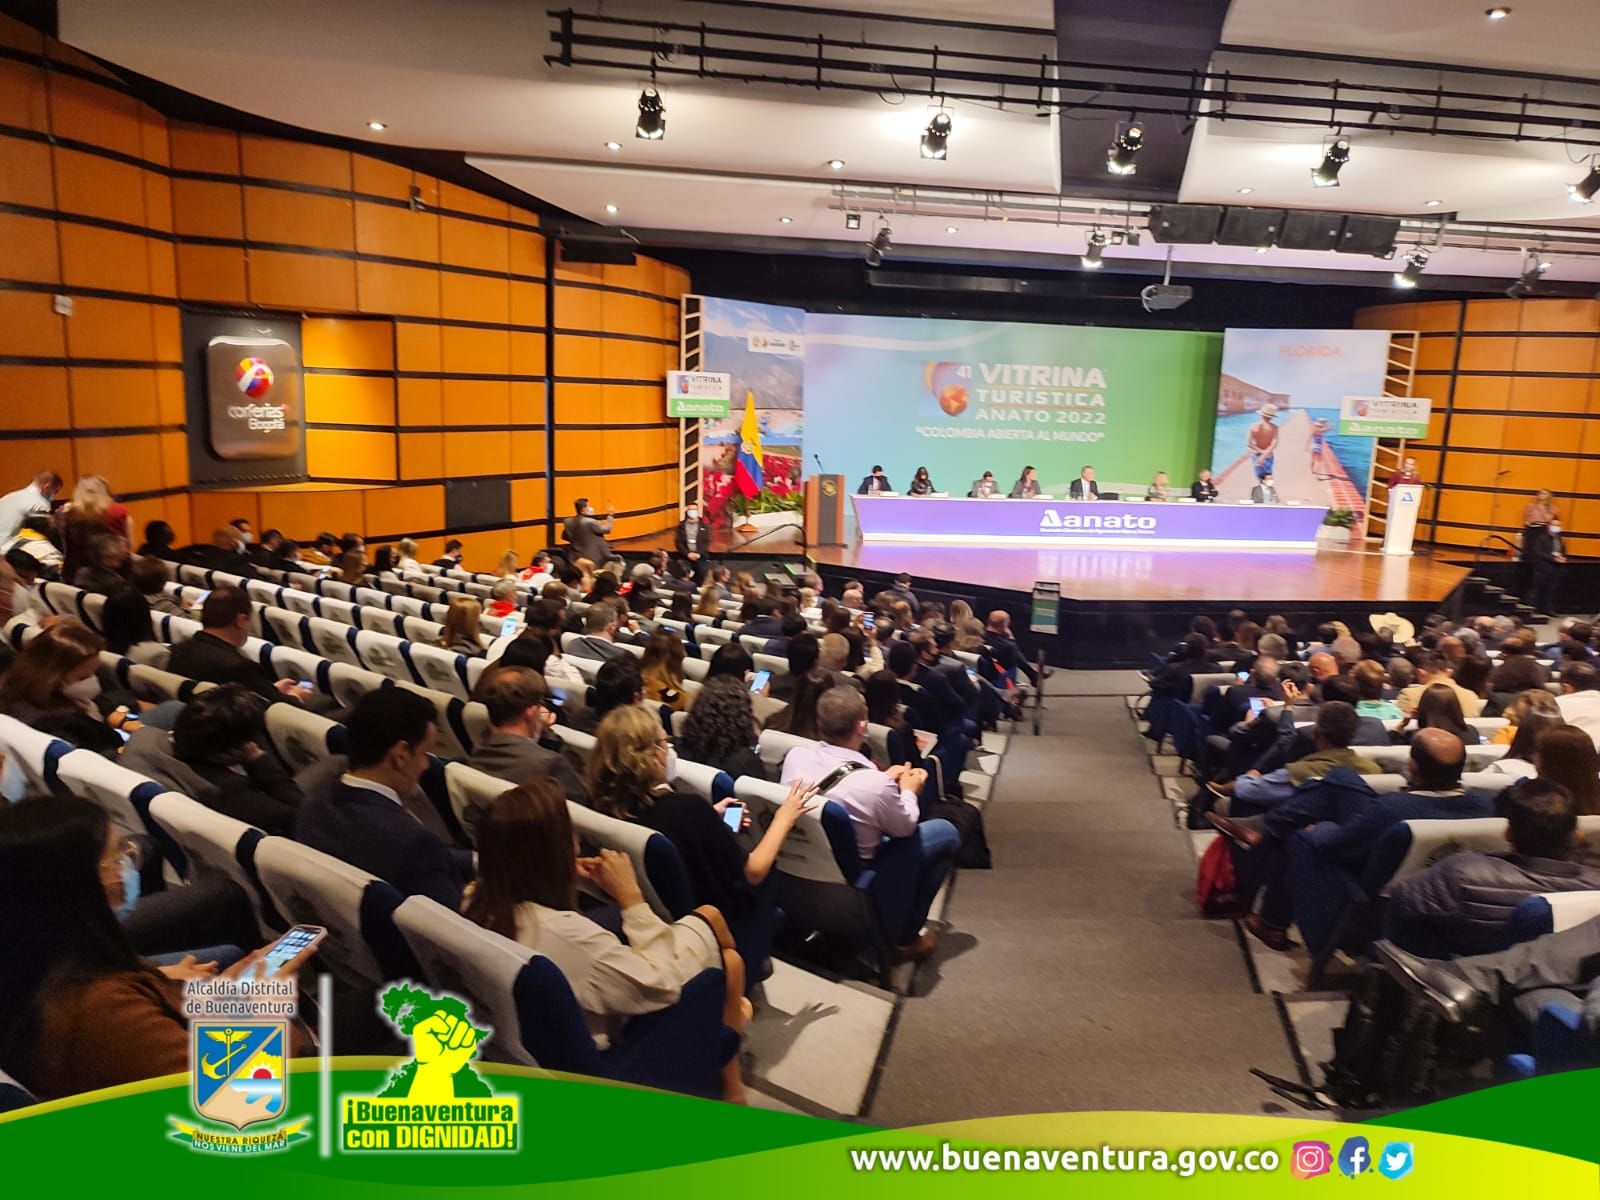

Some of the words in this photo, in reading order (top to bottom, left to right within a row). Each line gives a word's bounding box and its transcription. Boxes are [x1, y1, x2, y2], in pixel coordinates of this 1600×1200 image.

[956, 364, 971, 379] 41
[978, 363, 1107, 388] VITRINA
[976, 386, 1106, 407] TURÍSTICA
[227, 403, 284, 419] corferias
[975, 408, 1051, 423] ANATO
[1055, 410, 1106, 425] 2022
[987, 429, 1033, 441] ABIERTA
[1036, 431, 1051, 441] AL
